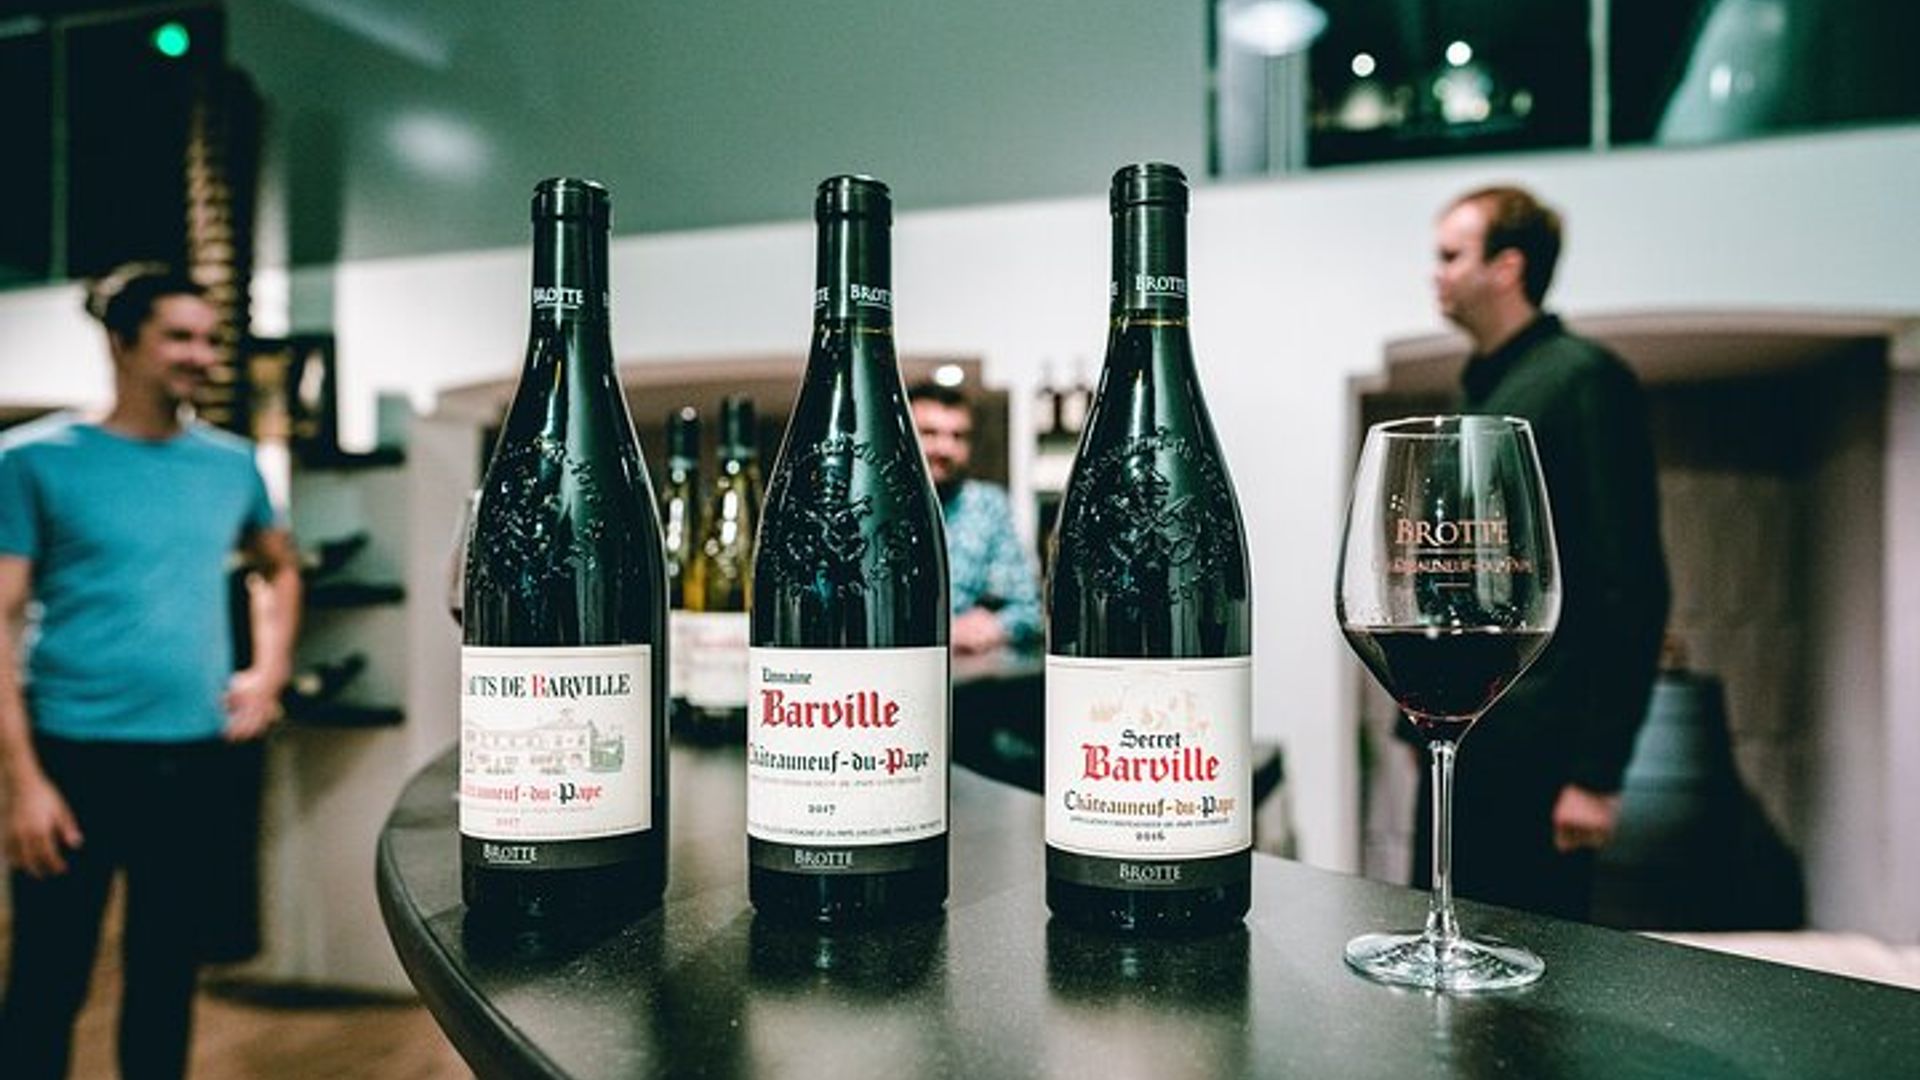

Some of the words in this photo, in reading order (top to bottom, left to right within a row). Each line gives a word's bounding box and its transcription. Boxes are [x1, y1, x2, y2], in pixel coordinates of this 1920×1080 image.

[1395, 518, 1510, 547] BROTTE
[762, 667, 812, 685] Domaine
[501, 676, 527, 698] DE
[532, 673, 631, 700] BARVILLE
[760, 689, 900, 729] Barville
[1120, 729, 1181, 750] Secret
[1081, 743, 1220, 783] Barville
[808, 804, 836, 817] 2017
[483, 844, 537, 862] BROTTE
[794, 850, 854, 867] BROTTE
[1119, 863, 1181, 881] BROTTE
